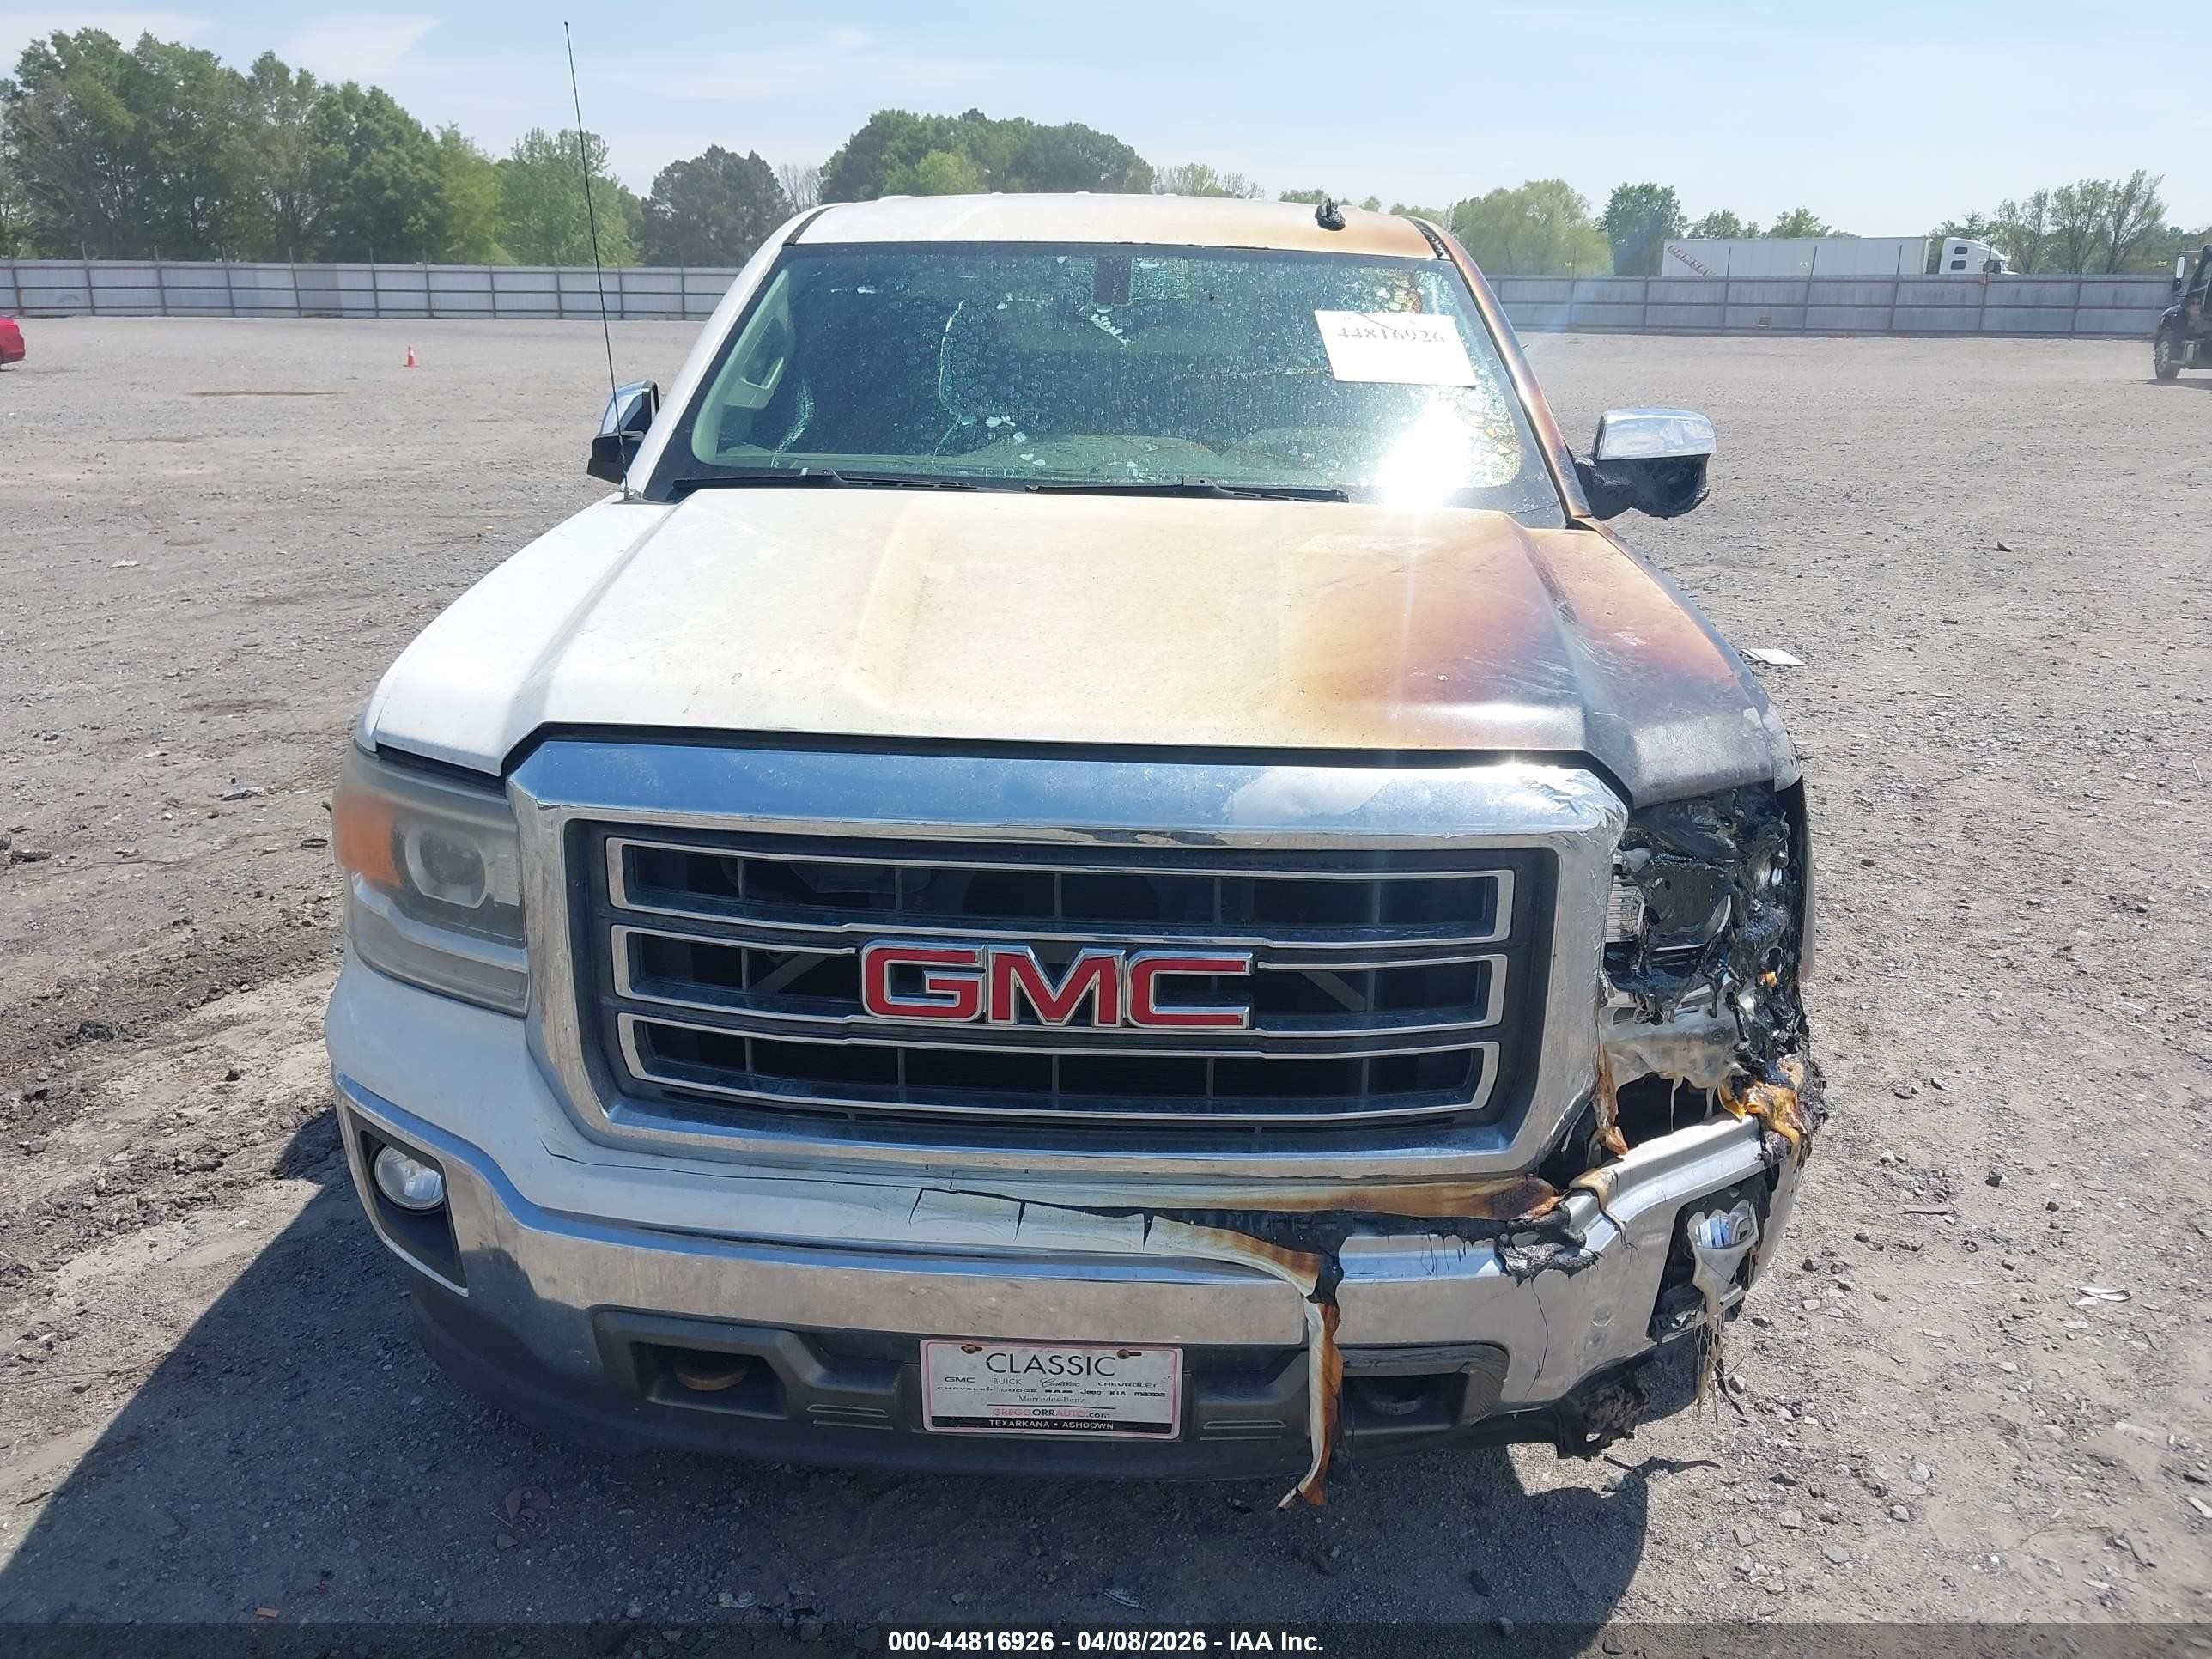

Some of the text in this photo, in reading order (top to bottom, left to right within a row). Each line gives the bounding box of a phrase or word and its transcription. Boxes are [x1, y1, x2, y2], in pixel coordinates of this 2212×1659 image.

[1337, 327, 1444, 343] 44816926
[860, 939, 1254, 1030] GMC
[986, 1352, 1116, 1376] CLASSIC
[1018, 1394, 1085, 1403] Mercedes-Benz
[992, 1407, 1110, 1419] GREGGORRAUTO.com
[989, 1419, 1115, 1430] TEXARKANA ASHDOWN
